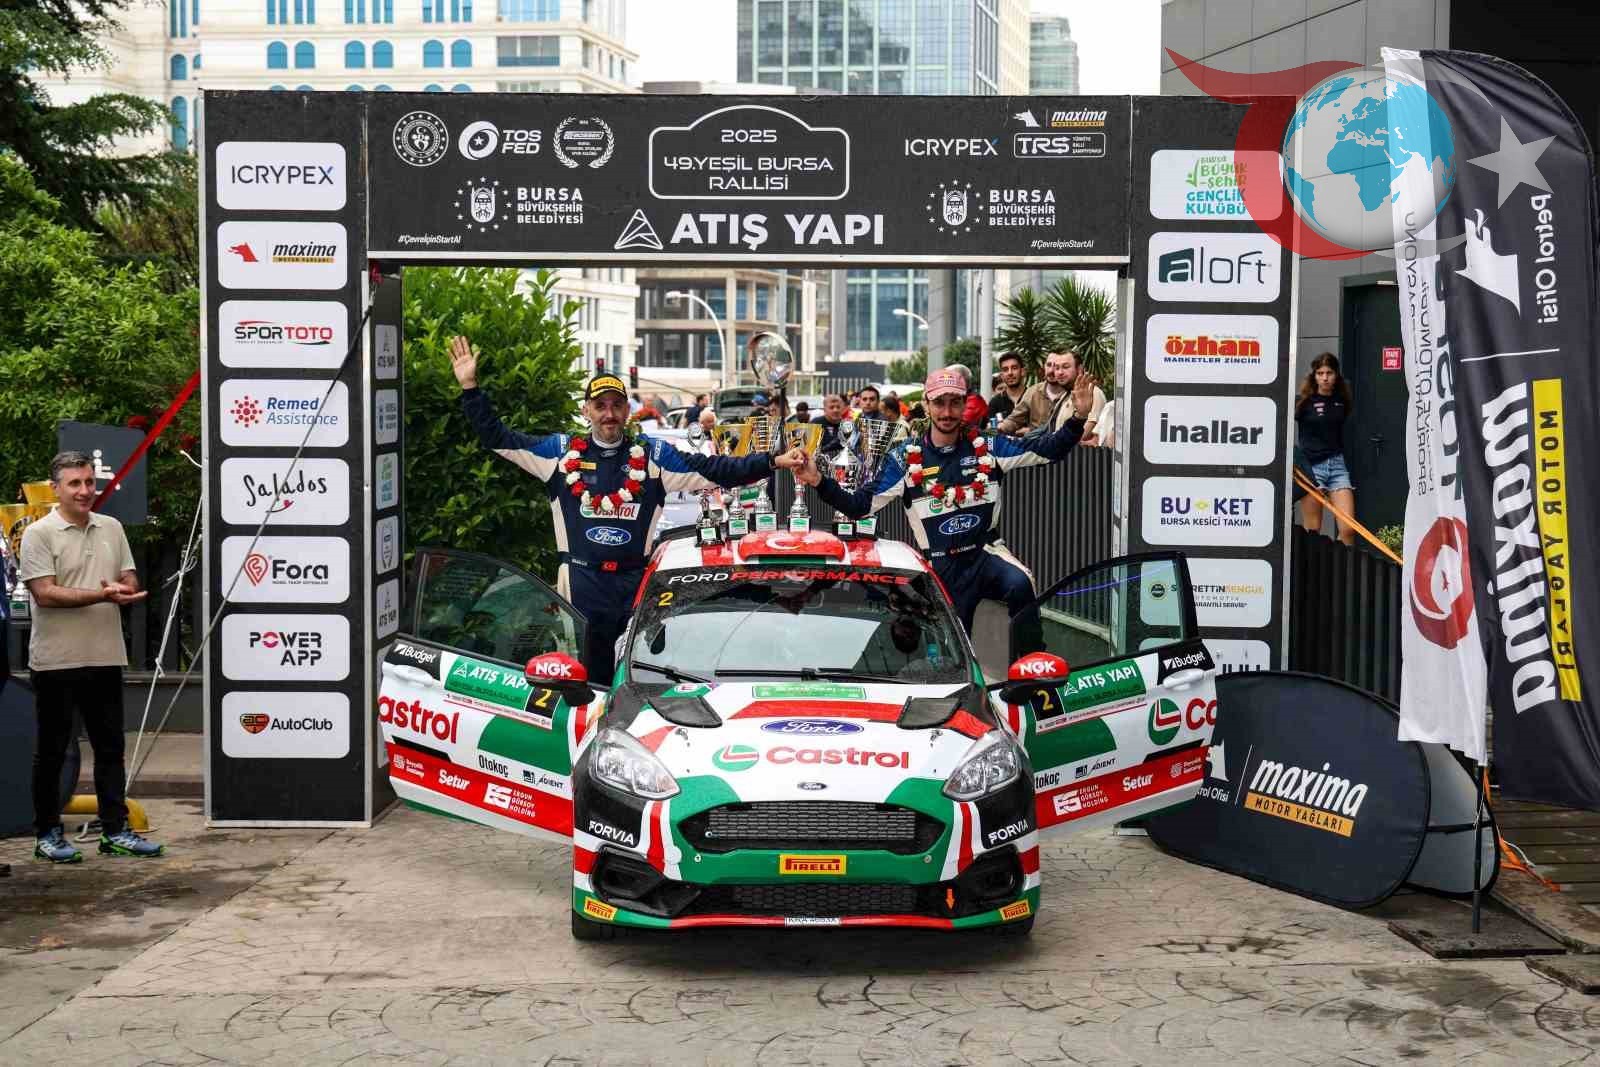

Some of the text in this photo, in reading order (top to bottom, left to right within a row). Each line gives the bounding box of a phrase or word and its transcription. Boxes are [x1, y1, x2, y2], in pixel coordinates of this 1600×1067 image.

[1051, 107, 1107, 121] maxima
[502, 129, 542, 141] TOS
[721, 129, 777, 142] 2025
[501, 142, 541, 154] FED
[904, 139, 999, 156] ICRYPEX
[1017, 137, 1071, 154] TRS
[758, 157, 834, 171] BURSA
[231, 165, 334, 184] ICRYPEX
[709, 174, 788, 190] RALLİSİ
[517, 188, 583, 200] BURSA
[990, 190, 1055, 203] BURSA
[670, 213, 883, 250] ATIŞ YAPI
[273, 241, 336, 256] maxima
[1159, 246, 1266, 284] aloft
[266, 397, 319, 411] Remed
[266, 412, 338, 425] Assistance
[243, 469, 327, 507] Salados
[1160, 517, 1190, 526] BURSA
[1223, 519, 1251, 527] TAKIM
[272, 559, 328, 580] Fora
[658, 592, 674, 606] 2
[250, 632, 322, 648] POWER
[280, 650, 322, 666] APP
[1175, 651, 1205, 668] Budget
[535, 662, 572, 678] NGK
[1020, 661, 1056, 676] NGK
[1077, 666, 1137, 690] ATIŞ YAPI
[534, 689, 552, 708] 2
[1037, 690, 1054, 711] 2
[271, 718, 333, 730] AutoClub
[765, 746, 909, 769] Castrol
[478, 755, 509, 778] Otokoç
[438, 769, 470, 790] Setur
[1122, 773, 1154, 792] Setur
[1250, 759, 1368, 817] maxima
[1211, 787, 1230, 802] Ofisi
[1255, 798, 1343, 830] MOTOR YAĞLARI
[588, 820, 635, 845] FORVIA
[988, 819, 1029, 844] FORVIA
[785, 858, 841, 871] PIRELLI
[586, 900, 614, 919] PIRELLI
[1002, 902, 1028, 919] PIRELLI
